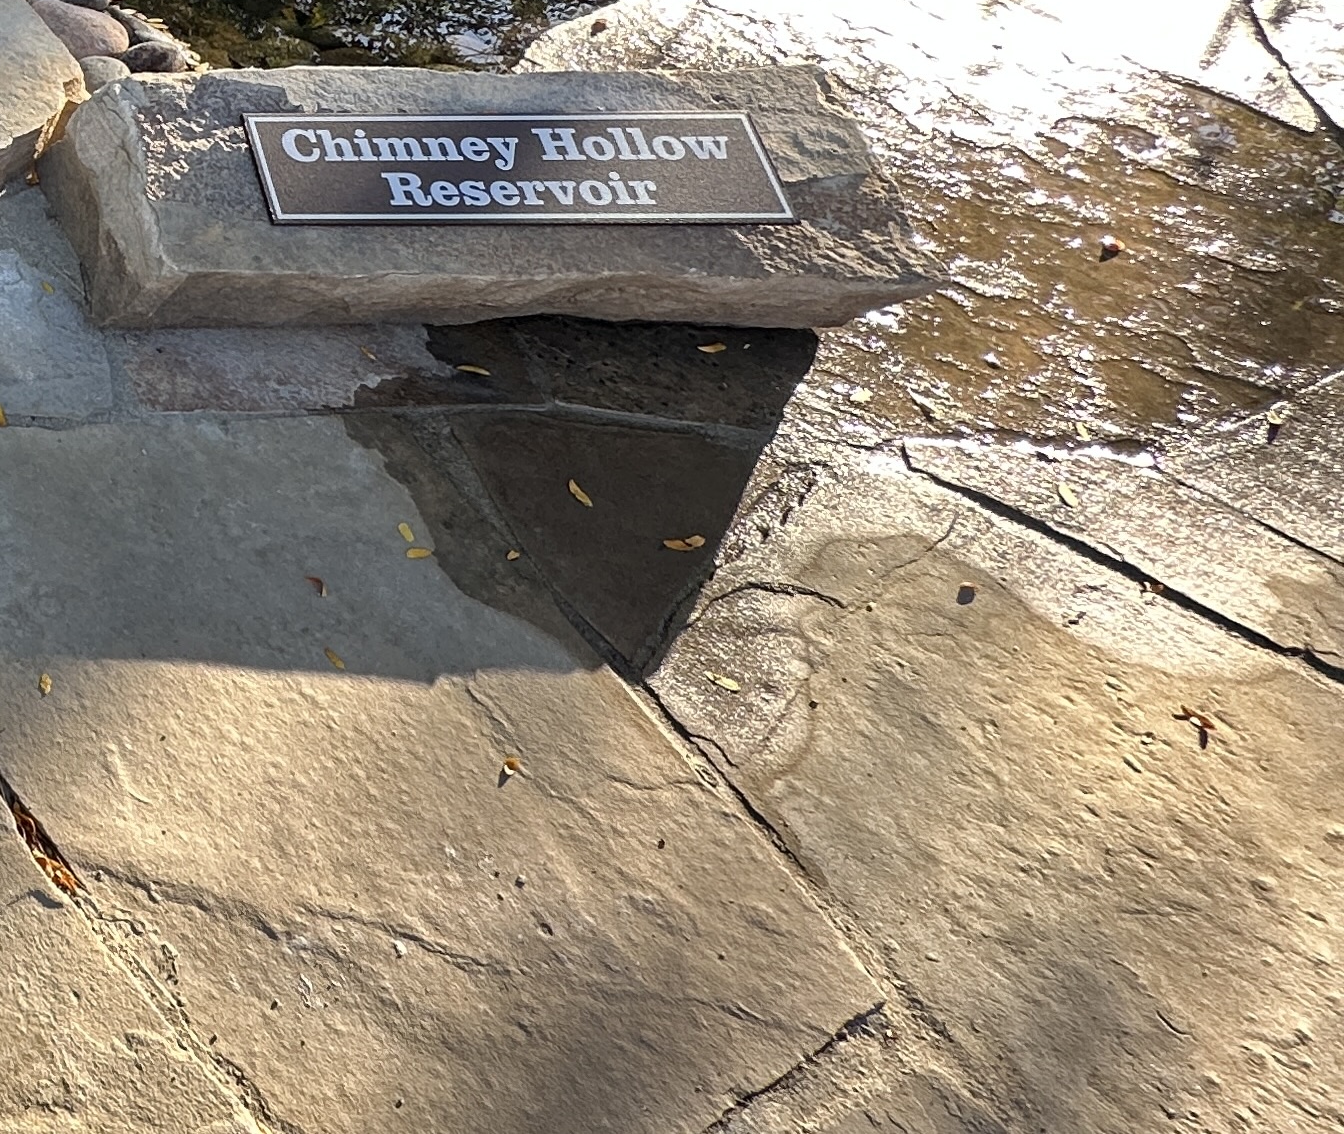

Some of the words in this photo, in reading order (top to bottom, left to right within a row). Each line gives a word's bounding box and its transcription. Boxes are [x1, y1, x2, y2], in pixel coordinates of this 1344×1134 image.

[281, 128, 519, 170] Chimney
[531, 127, 729, 162] Hollow
[381, 171, 658, 207] Reservoir
